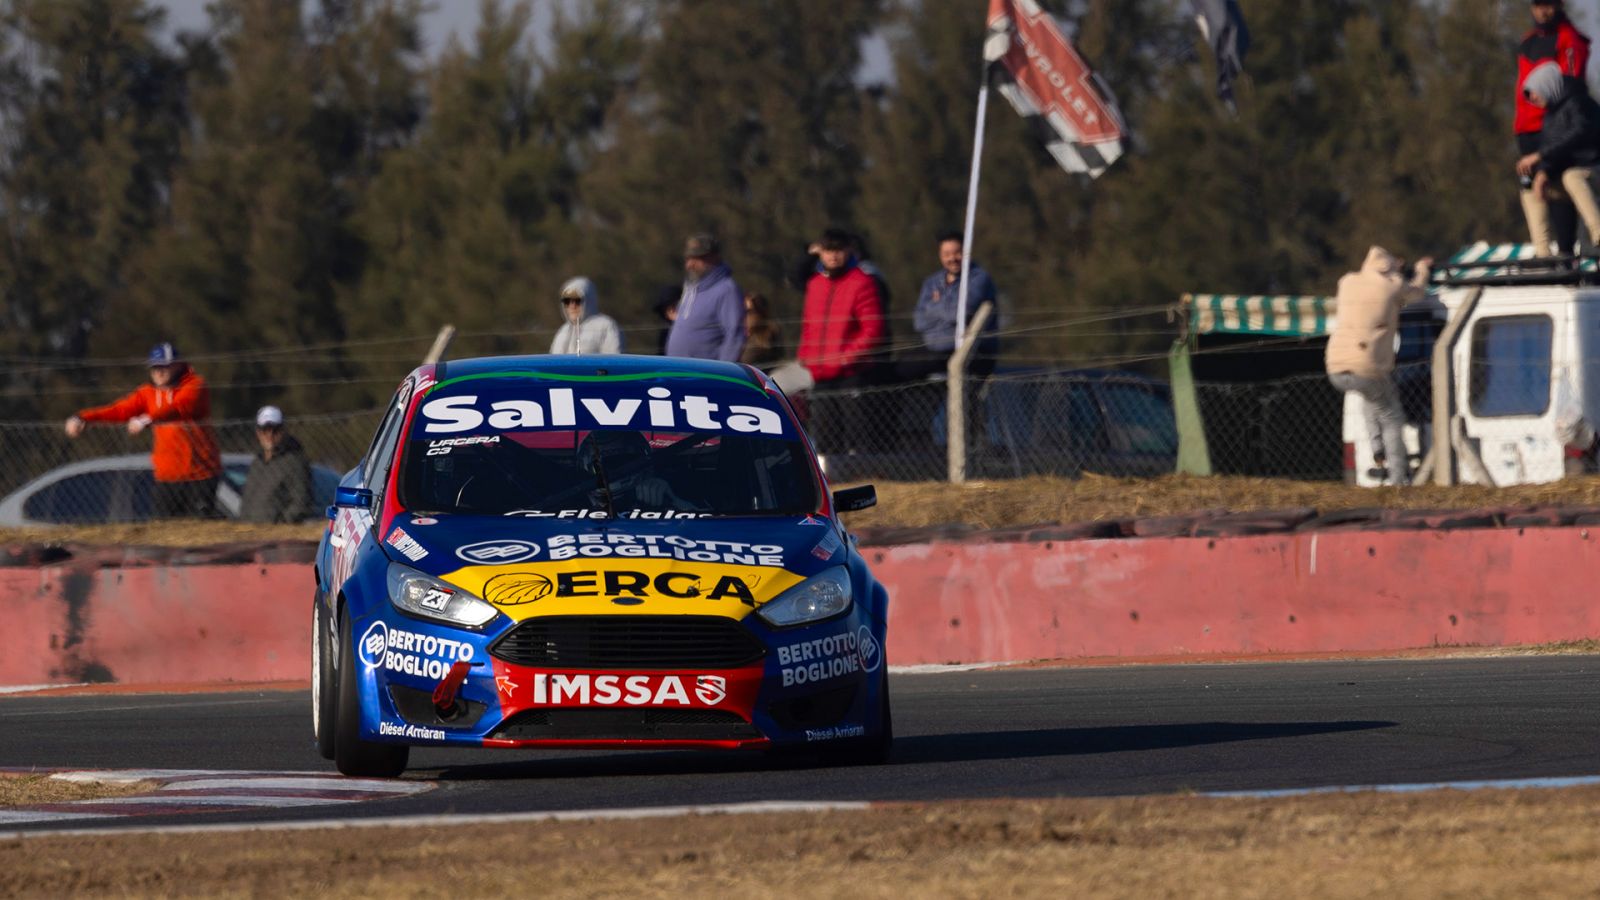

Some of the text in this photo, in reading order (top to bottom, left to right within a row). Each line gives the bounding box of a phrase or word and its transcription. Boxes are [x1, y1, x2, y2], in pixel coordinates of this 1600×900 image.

[422, 387, 783, 435] Salvita
[426, 447, 452, 456] C3
[429, 436, 500, 447] URCERA
[547, 534, 784, 554] BERTOTTO
[550, 544, 785, 566] BOGLIONE
[388, 629, 474, 662] BERTOTTO
[777, 631, 856, 666] BERTOTTO
[385, 652, 468, 684] BOGLION
[782, 653, 859, 687] BOGLIONE
[533, 673, 691, 705] IMSSA
